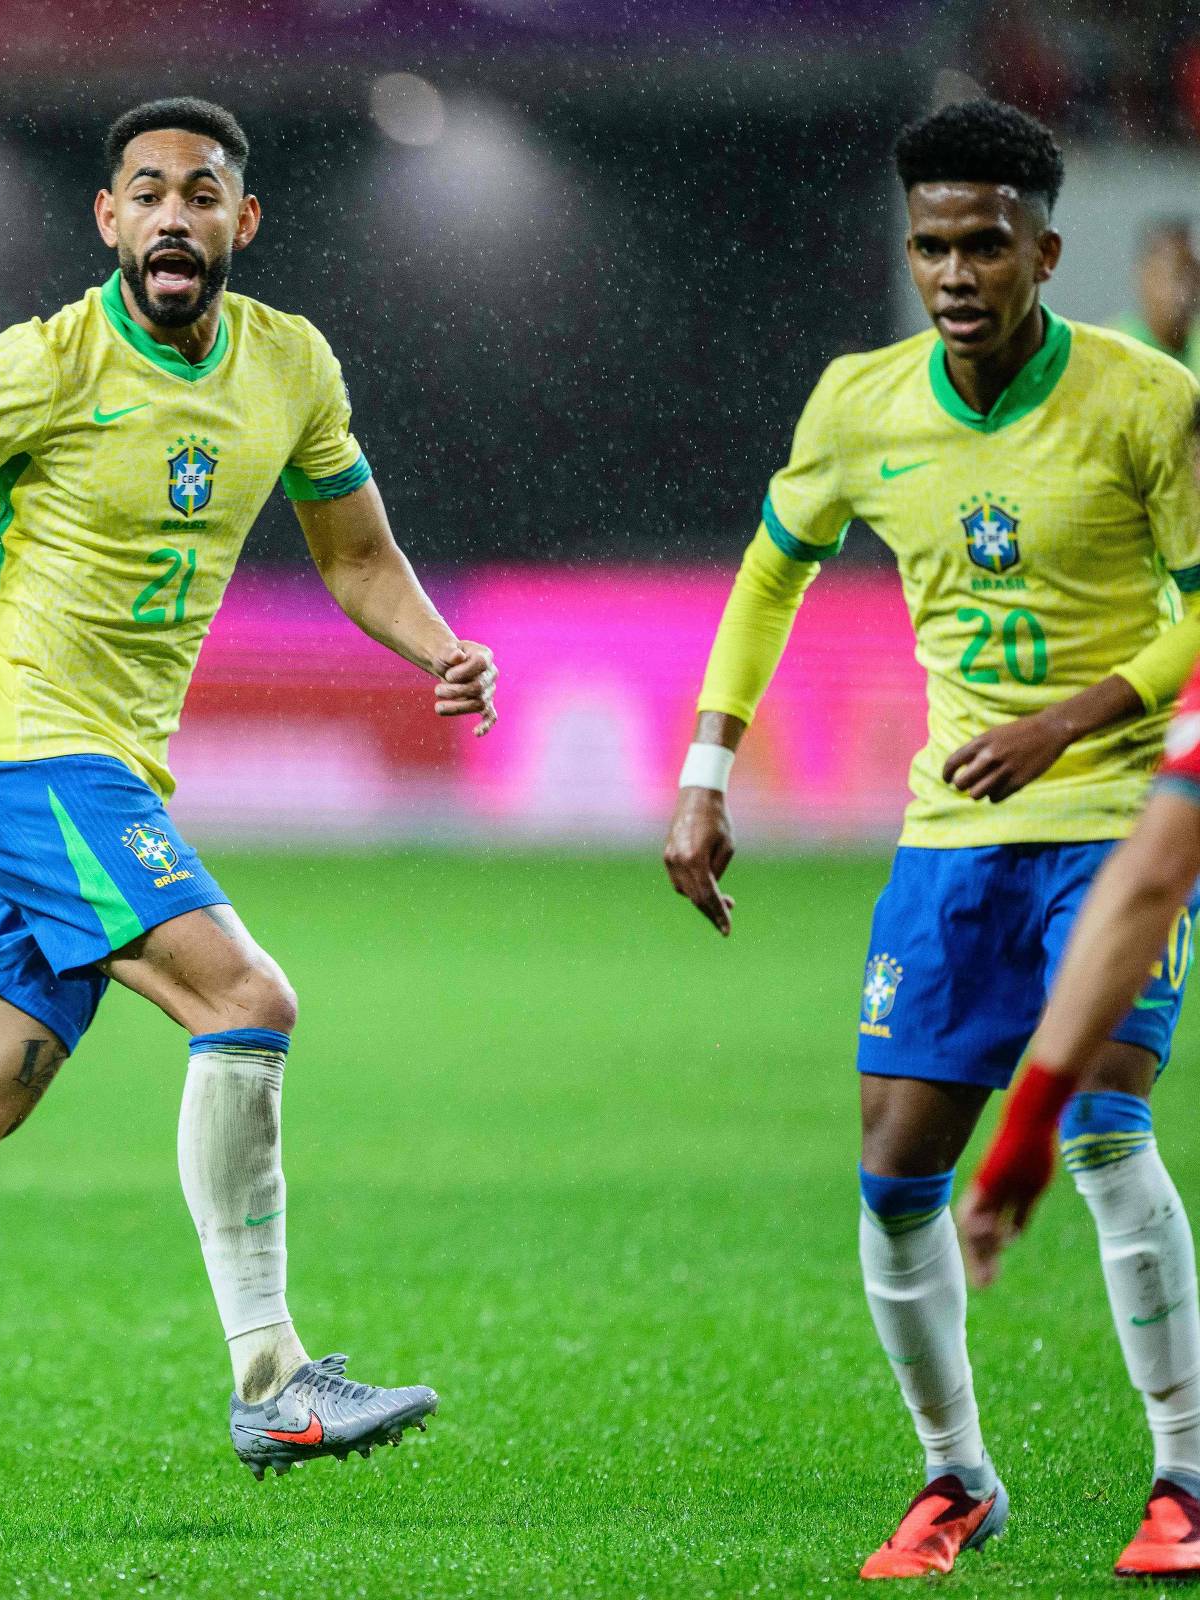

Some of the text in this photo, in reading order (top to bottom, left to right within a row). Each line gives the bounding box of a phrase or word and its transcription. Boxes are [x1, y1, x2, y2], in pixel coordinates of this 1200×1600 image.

[182, 475, 200, 484] CBF
[132, 547, 196, 623] 21
[971, 577, 1028, 590] BRASIL
[956, 607, 1047, 686] 20
[153, 870, 195, 888] BRASIL
